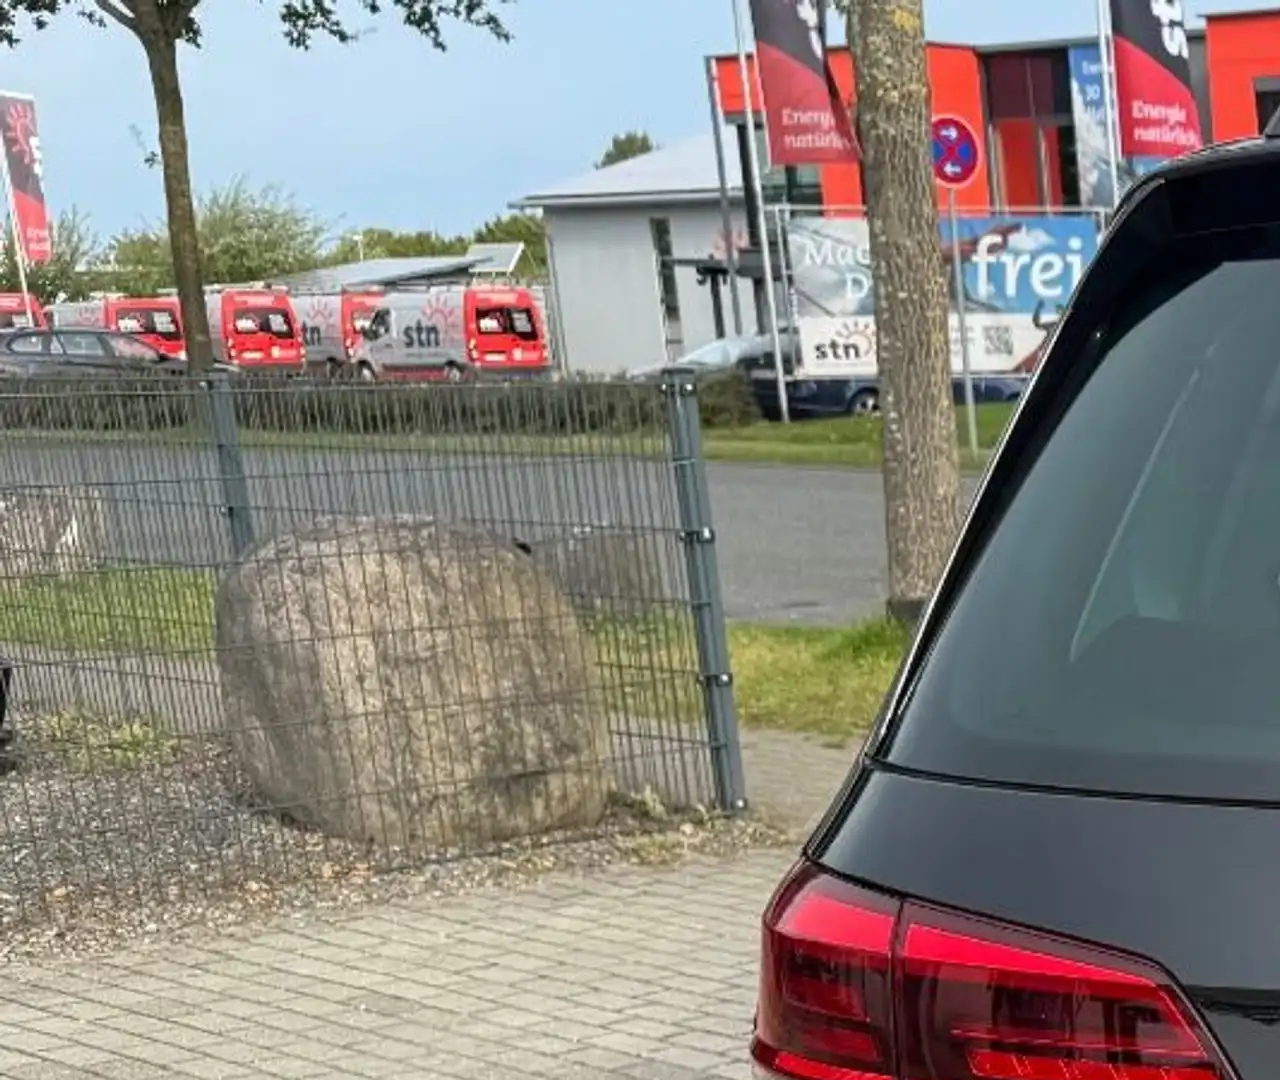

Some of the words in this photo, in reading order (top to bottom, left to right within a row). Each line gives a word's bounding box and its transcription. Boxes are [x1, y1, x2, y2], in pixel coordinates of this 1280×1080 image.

[804, 239, 870, 265] Mac
[301, 320, 321, 346] tn
[403, 319, 439, 348] stn
[814, 339, 860, 360] stn
